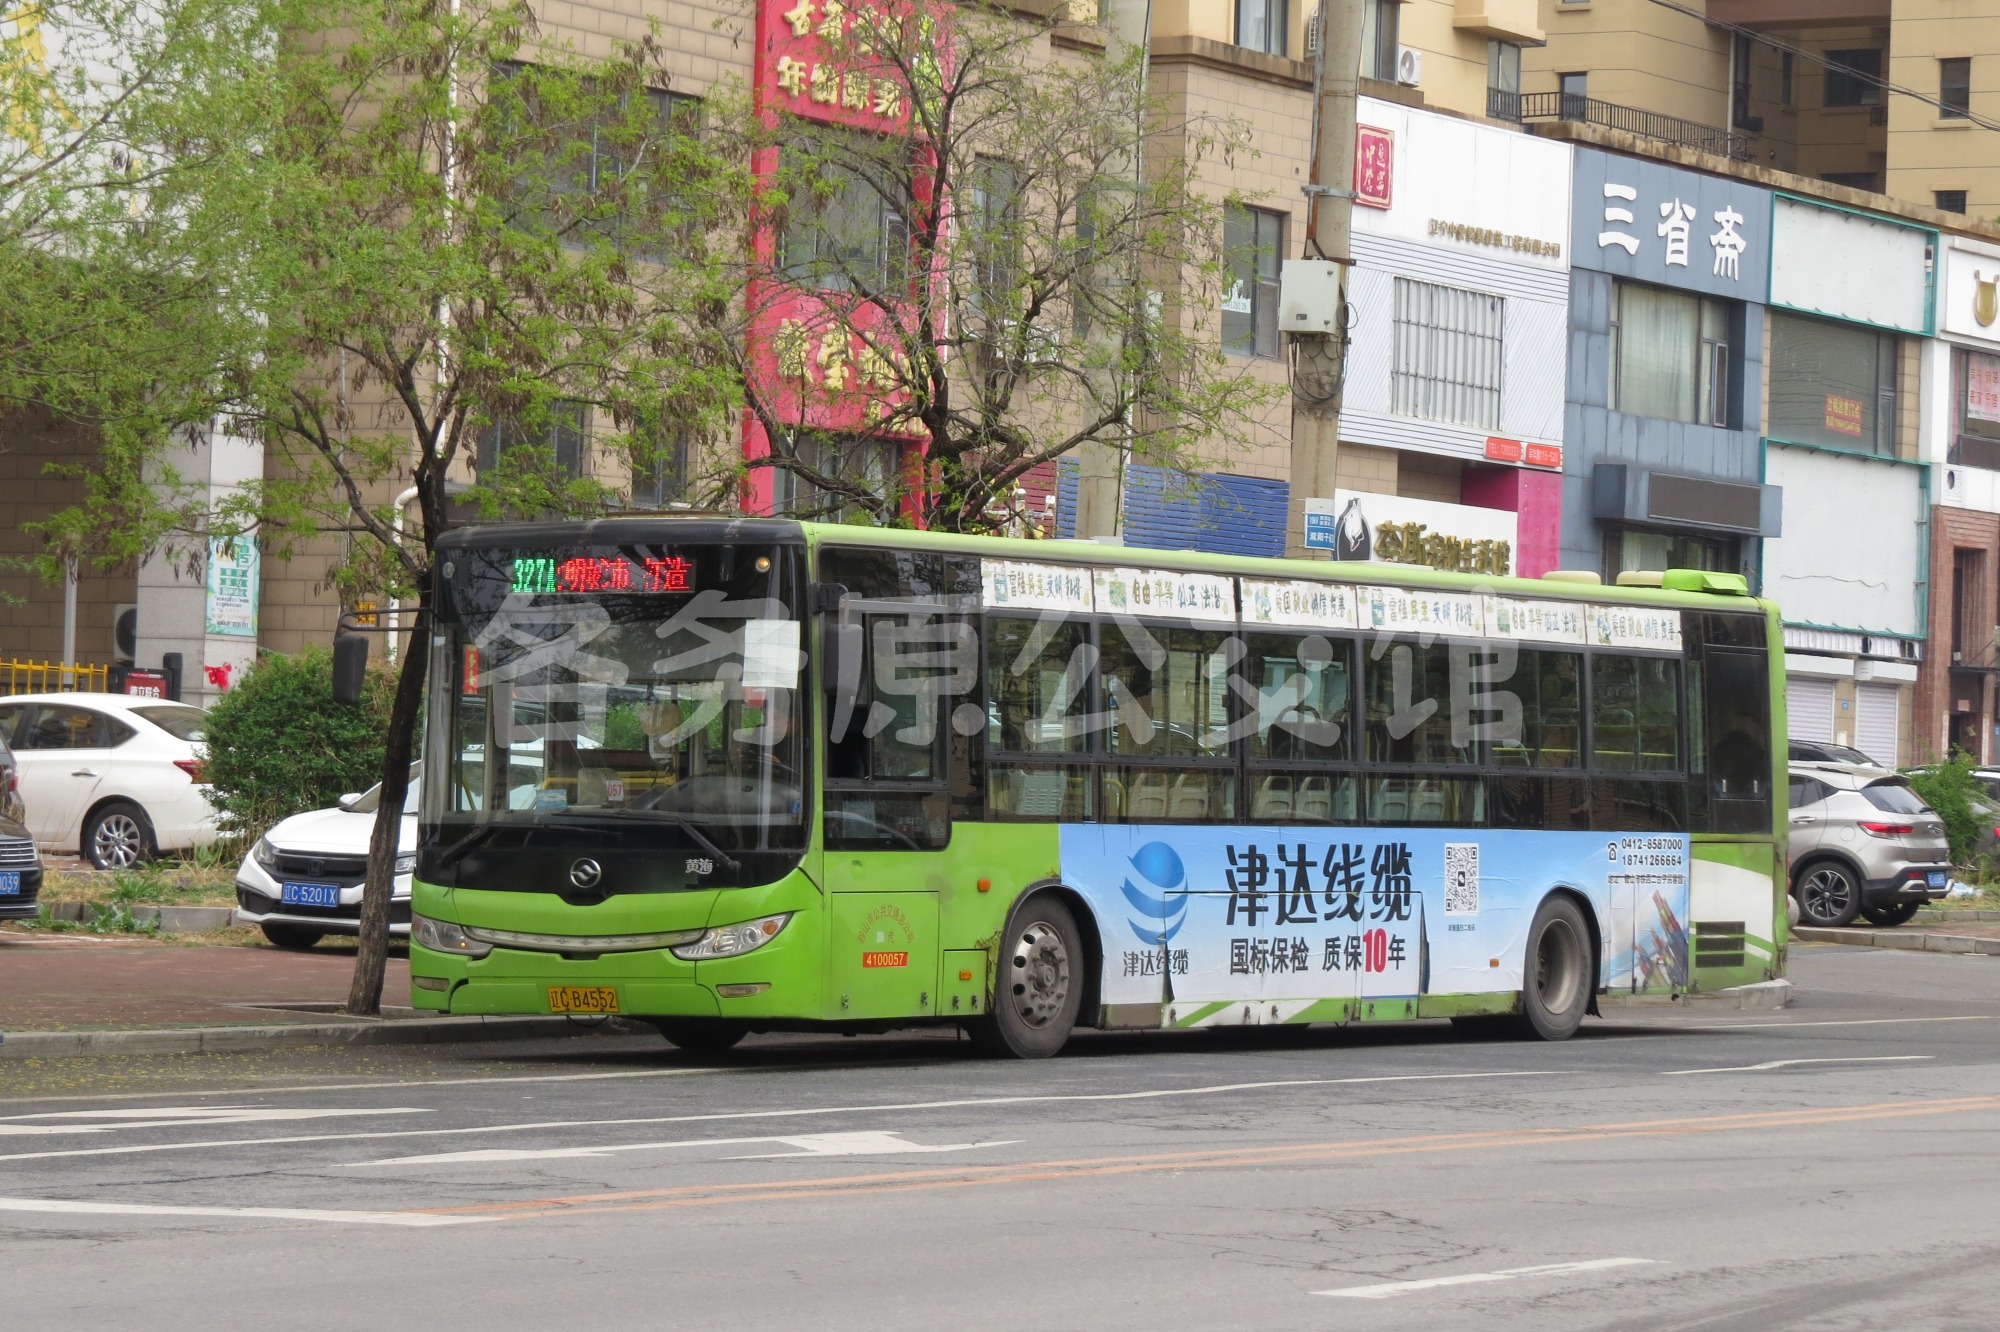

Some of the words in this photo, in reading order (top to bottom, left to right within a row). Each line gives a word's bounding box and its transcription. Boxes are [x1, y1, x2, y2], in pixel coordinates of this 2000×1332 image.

[1598, 183, 1747, 281] 三省斋
[1621, 838, 1683, 850] 0412-8587000
[685, 858, 714, 875] 黄海
[1622, 855, 1682, 866] 18741266664
[1225, 842, 1413, 926] 津达线缆
[866, 953, 904, 966] 4100057
[1230, 937, 1310, 975] 国标保检
[1322, 928, 1406, 973] 质保10年
[1123, 949, 1190, 977] 津达线缆
